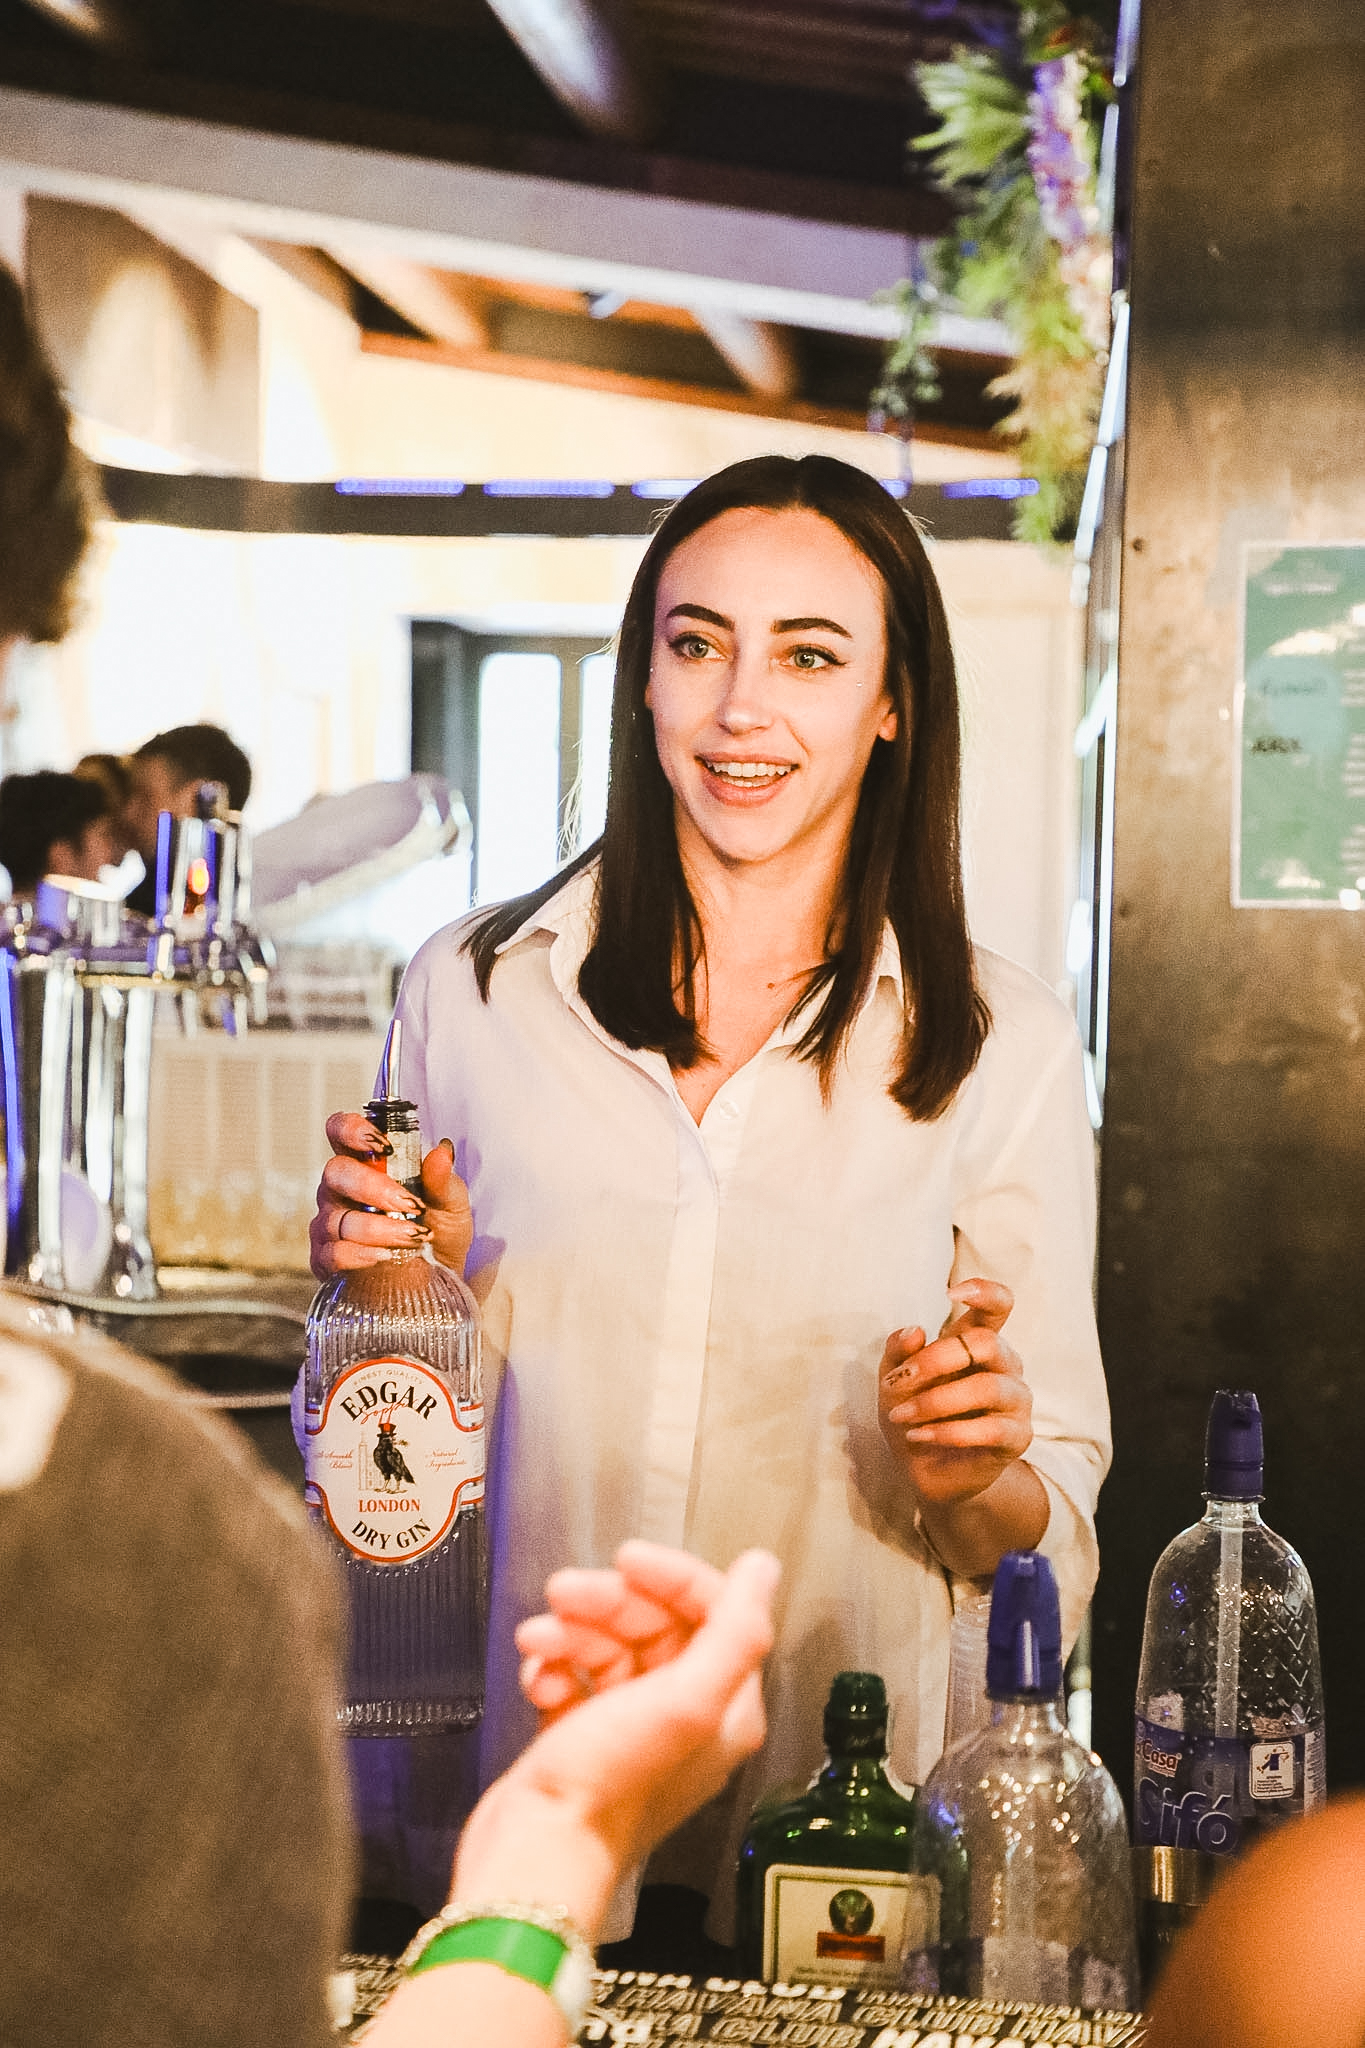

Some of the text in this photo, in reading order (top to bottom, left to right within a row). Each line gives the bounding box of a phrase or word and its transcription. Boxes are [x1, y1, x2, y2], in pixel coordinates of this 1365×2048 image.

[386, 1369, 425, 1385] QUALITY
[340, 1381, 437, 1421] EDGAR
[358, 1499, 420, 1514] LONDON
[351, 1518, 431, 1550] DRY GIN
